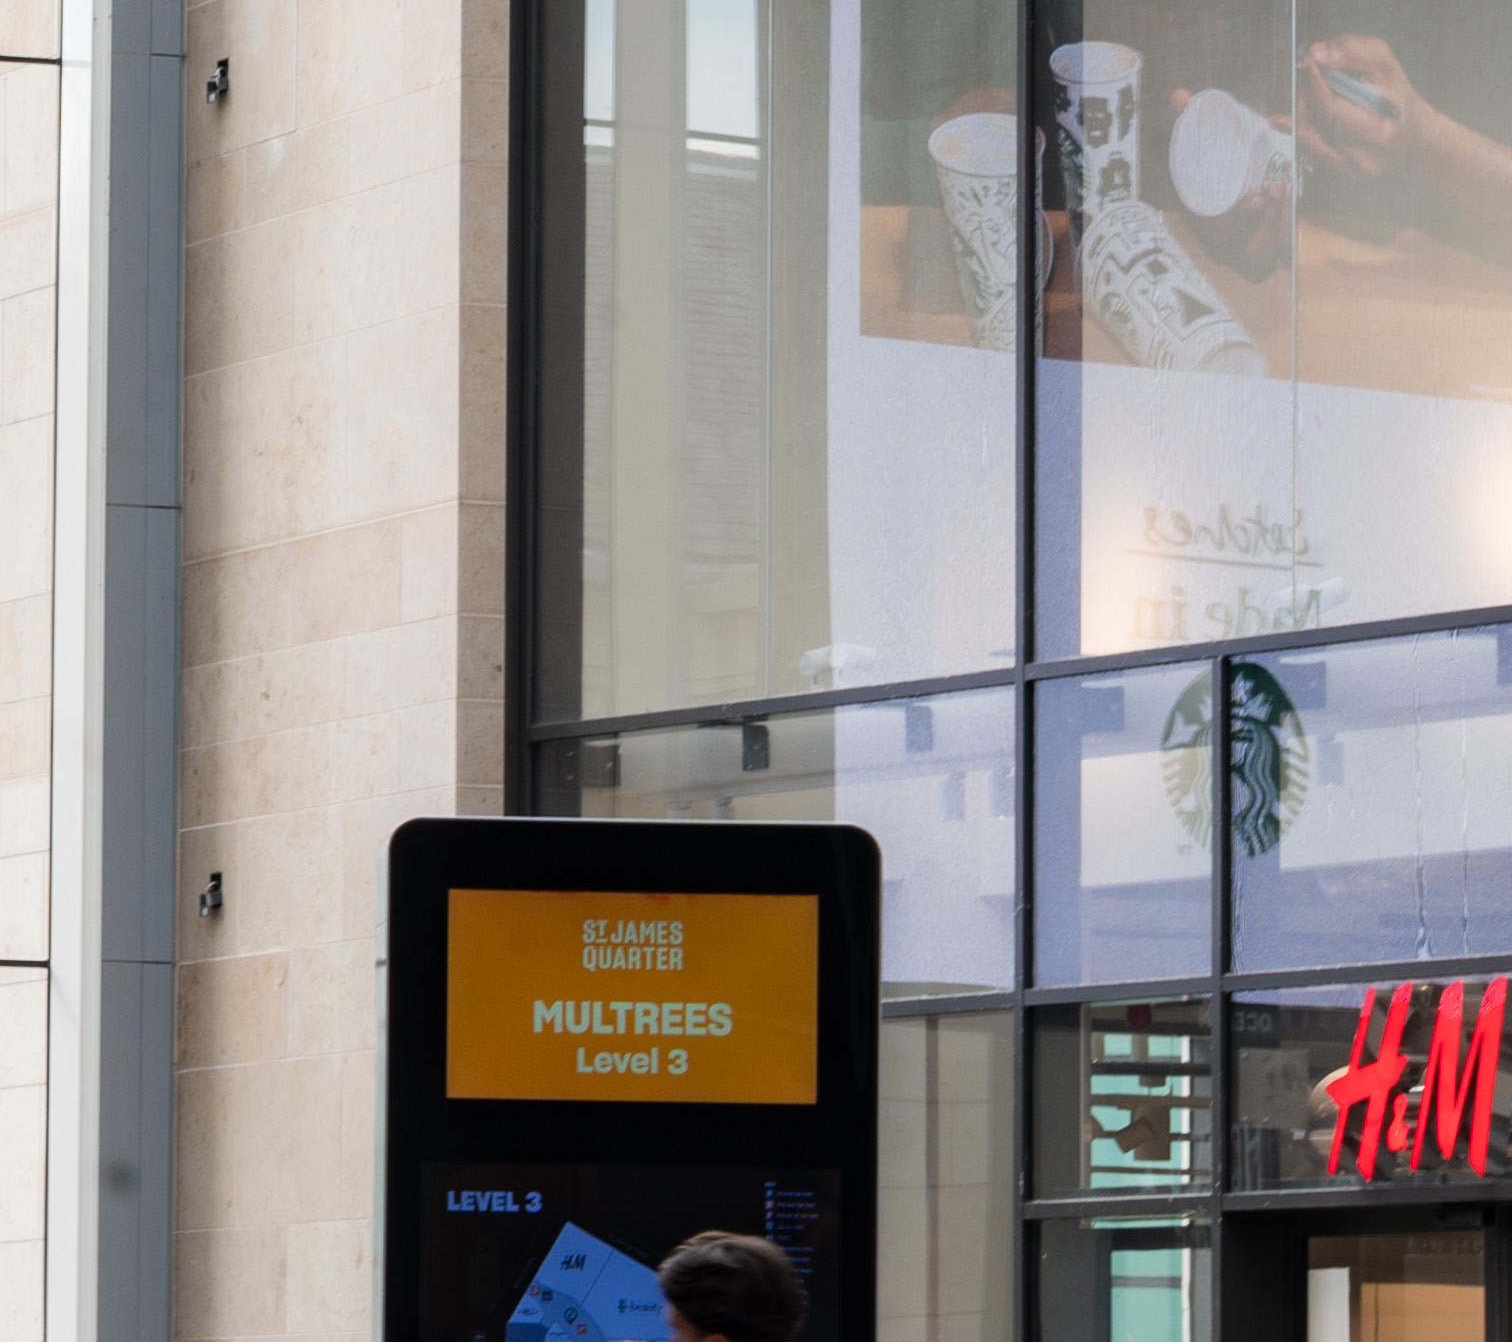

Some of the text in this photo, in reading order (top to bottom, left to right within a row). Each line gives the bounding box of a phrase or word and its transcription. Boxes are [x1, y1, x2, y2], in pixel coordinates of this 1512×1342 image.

[611, 921, 684, 945] JAMES
[583, 946, 684, 971] QUARTER
[533, 1000, 733, 1036] MULTREES
[577, 1047, 688, 1075] Level 3
[1325, 976, 1508, 1182] H&M
[447, 1191, 542, 1212] LEVEL 3
